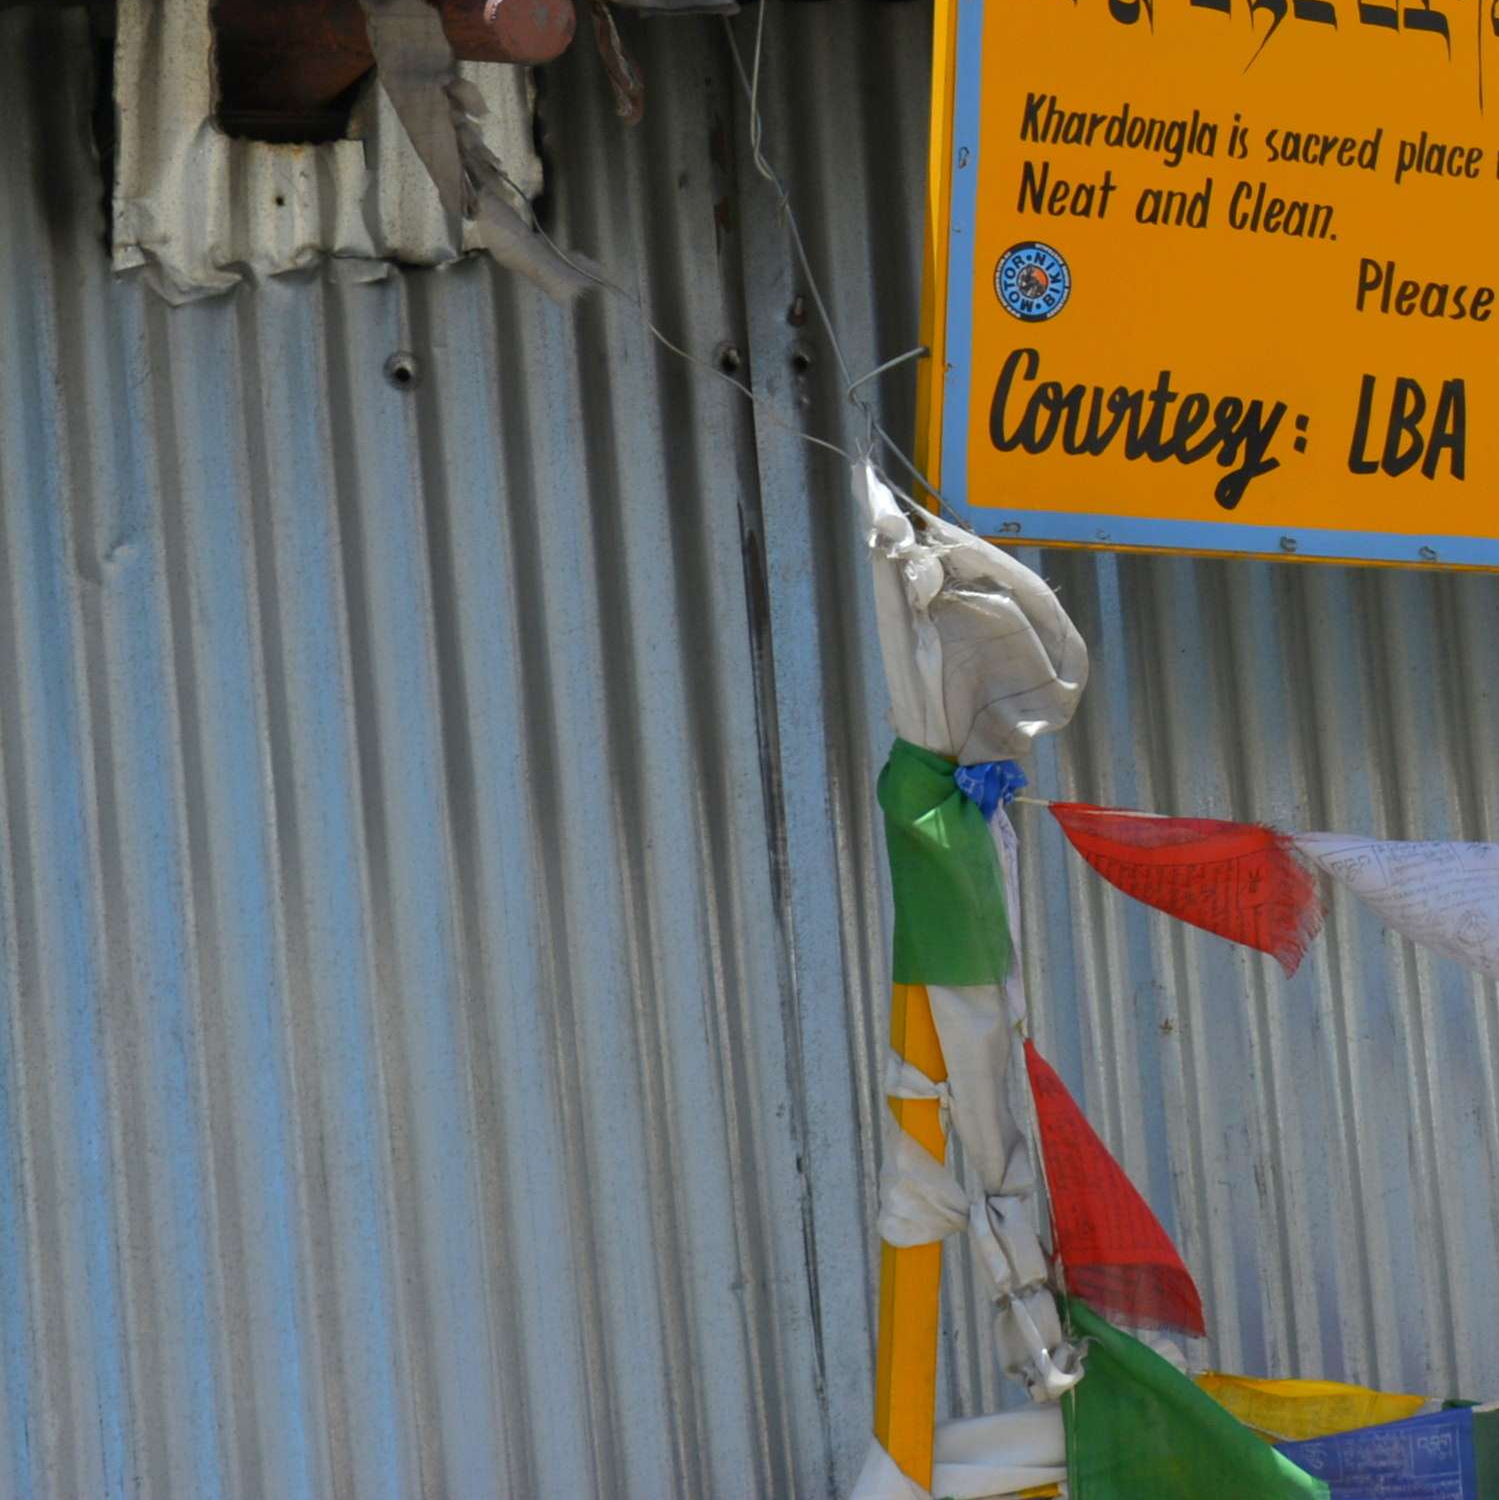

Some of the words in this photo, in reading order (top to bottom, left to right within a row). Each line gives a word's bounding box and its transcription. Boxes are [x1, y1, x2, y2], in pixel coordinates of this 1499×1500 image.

[1020, 93, 1218, 167] Khardongla
[1228, 114, 1248, 159] is
[1266, 129, 1382, 170] sacred
[1395, 132, 1483, 184] place
[1018, 161, 1116, 218] Neat
[1136, 178, 1212, 228] and
[1229, 181, 1336, 240] Clean.
[1357, 258, 1494, 321] Please
[1348, 374, 1466, 481] LBA
